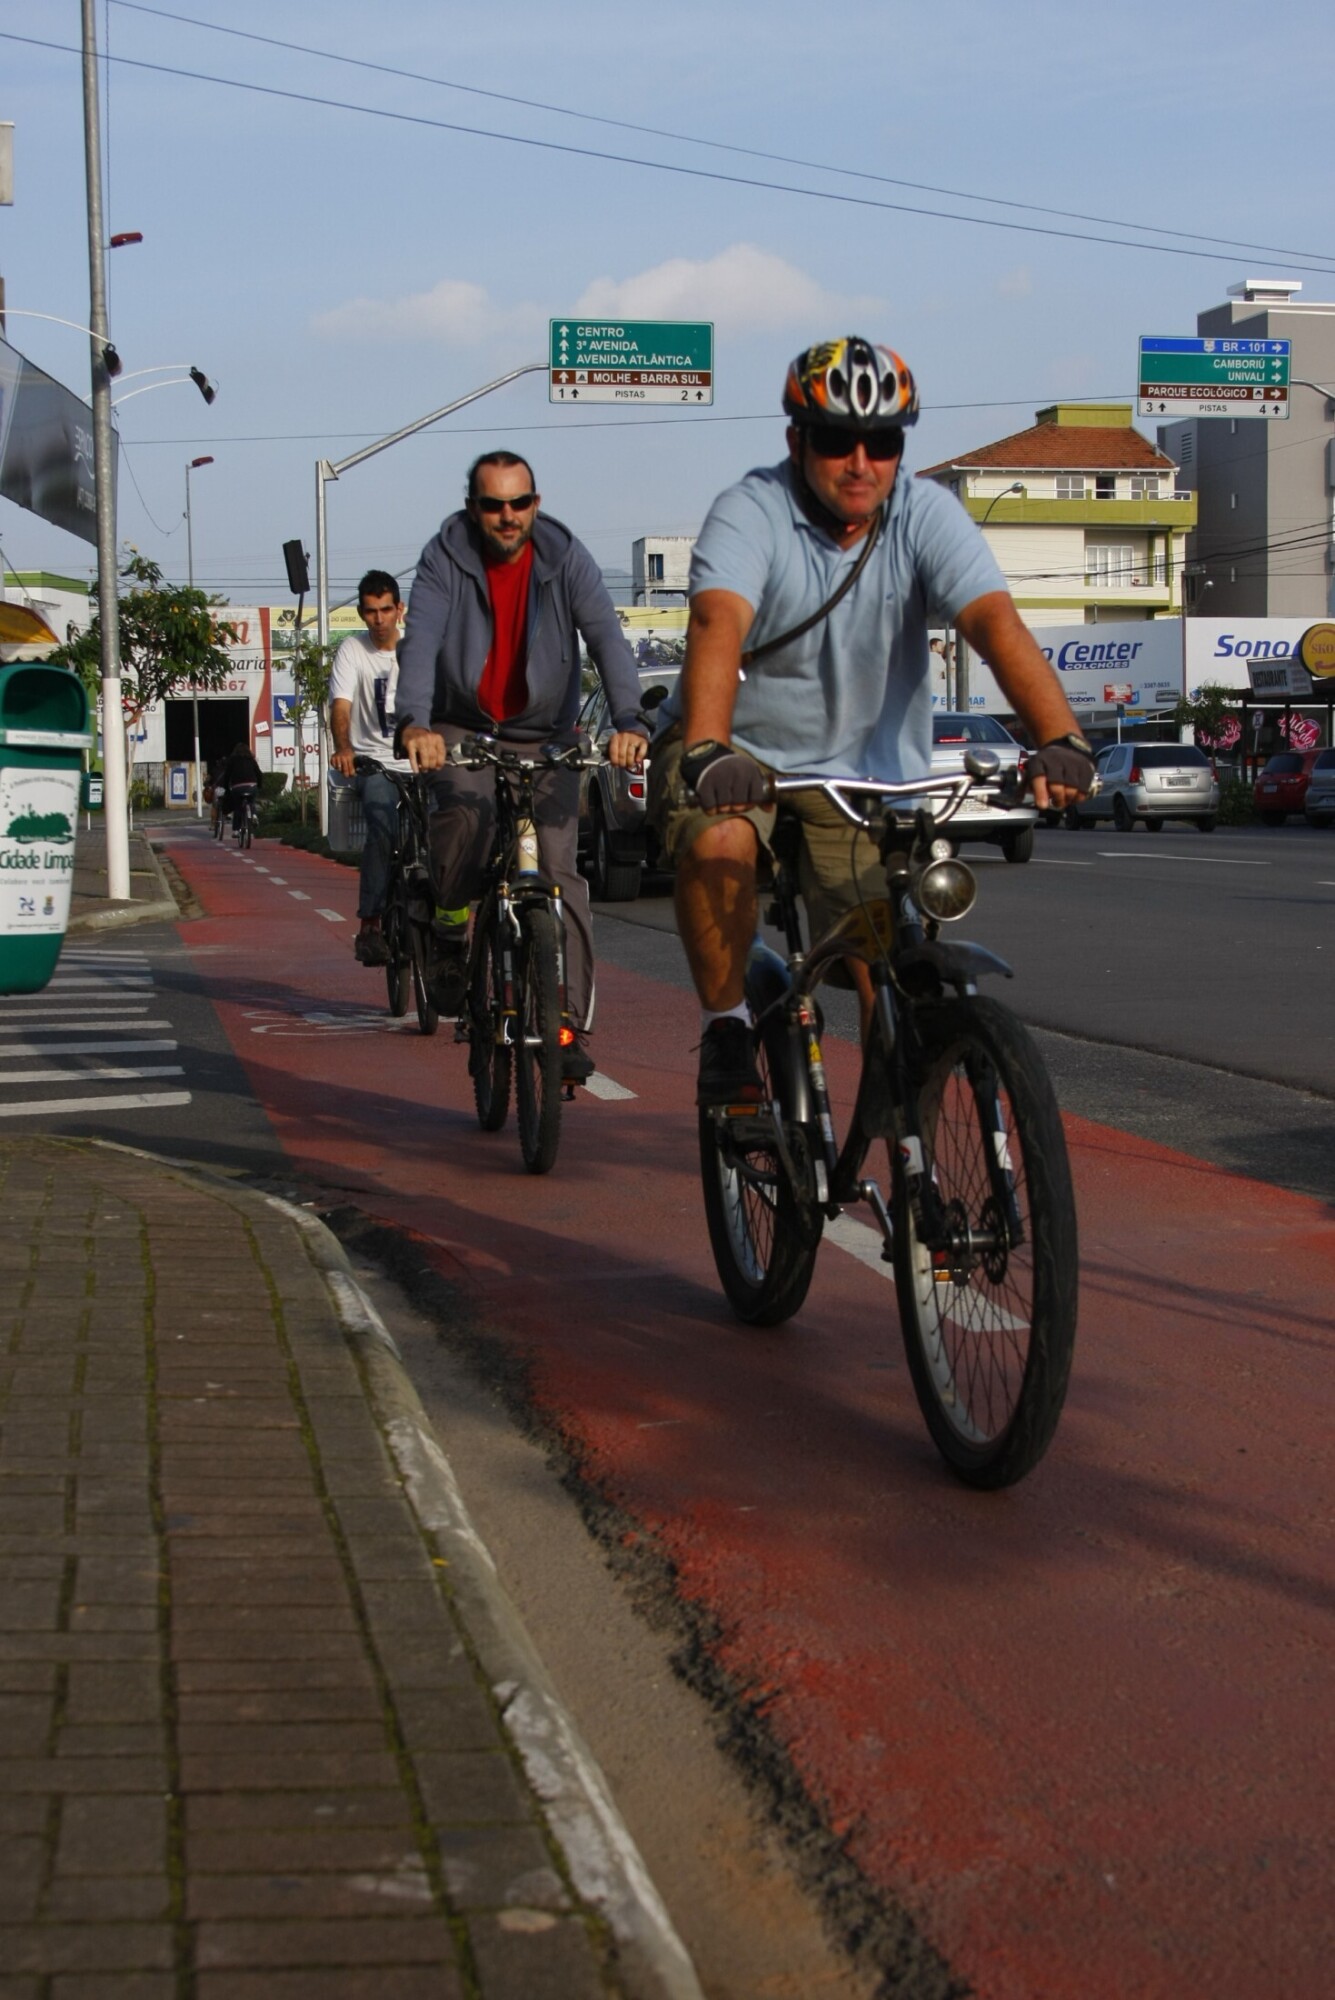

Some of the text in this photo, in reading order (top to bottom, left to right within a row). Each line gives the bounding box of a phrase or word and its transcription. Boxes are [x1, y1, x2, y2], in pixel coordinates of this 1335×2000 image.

[577, 327, 625, 338] CENTRO
[589, 341, 639, 351] AVENIDA
[1223, 342, 1239, 352] BR
[1249, 342, 1266, 352] 101
[576, 353, 692, 366] AVENIDA ATLÂNTICA
[1213, 357, 1266, 369] CAMBORIÚ
[593, 373, 631, 383] MOLHE
[640, 373, 678, 384] BARRA
[681, 374, 702, 384] SUL
[1228, 371, 1265, 382] UNIVALI
[559, 388, 689, 401] 1 PISTAS 2
[1148, 386, 1248, 398] PARQUE ECOLÓGICO
[1146, 402, 1266, 414] 3 PISTAS 4
[1214, 634, 1291, 657] Sono
[1312, 643, 1335, 654] SKO
[1057, 641, 1143, 671] Center
[1064, 660, 1129, 671] COLCHÕES
[0, 849, 74, 874] Cidade Limpa
